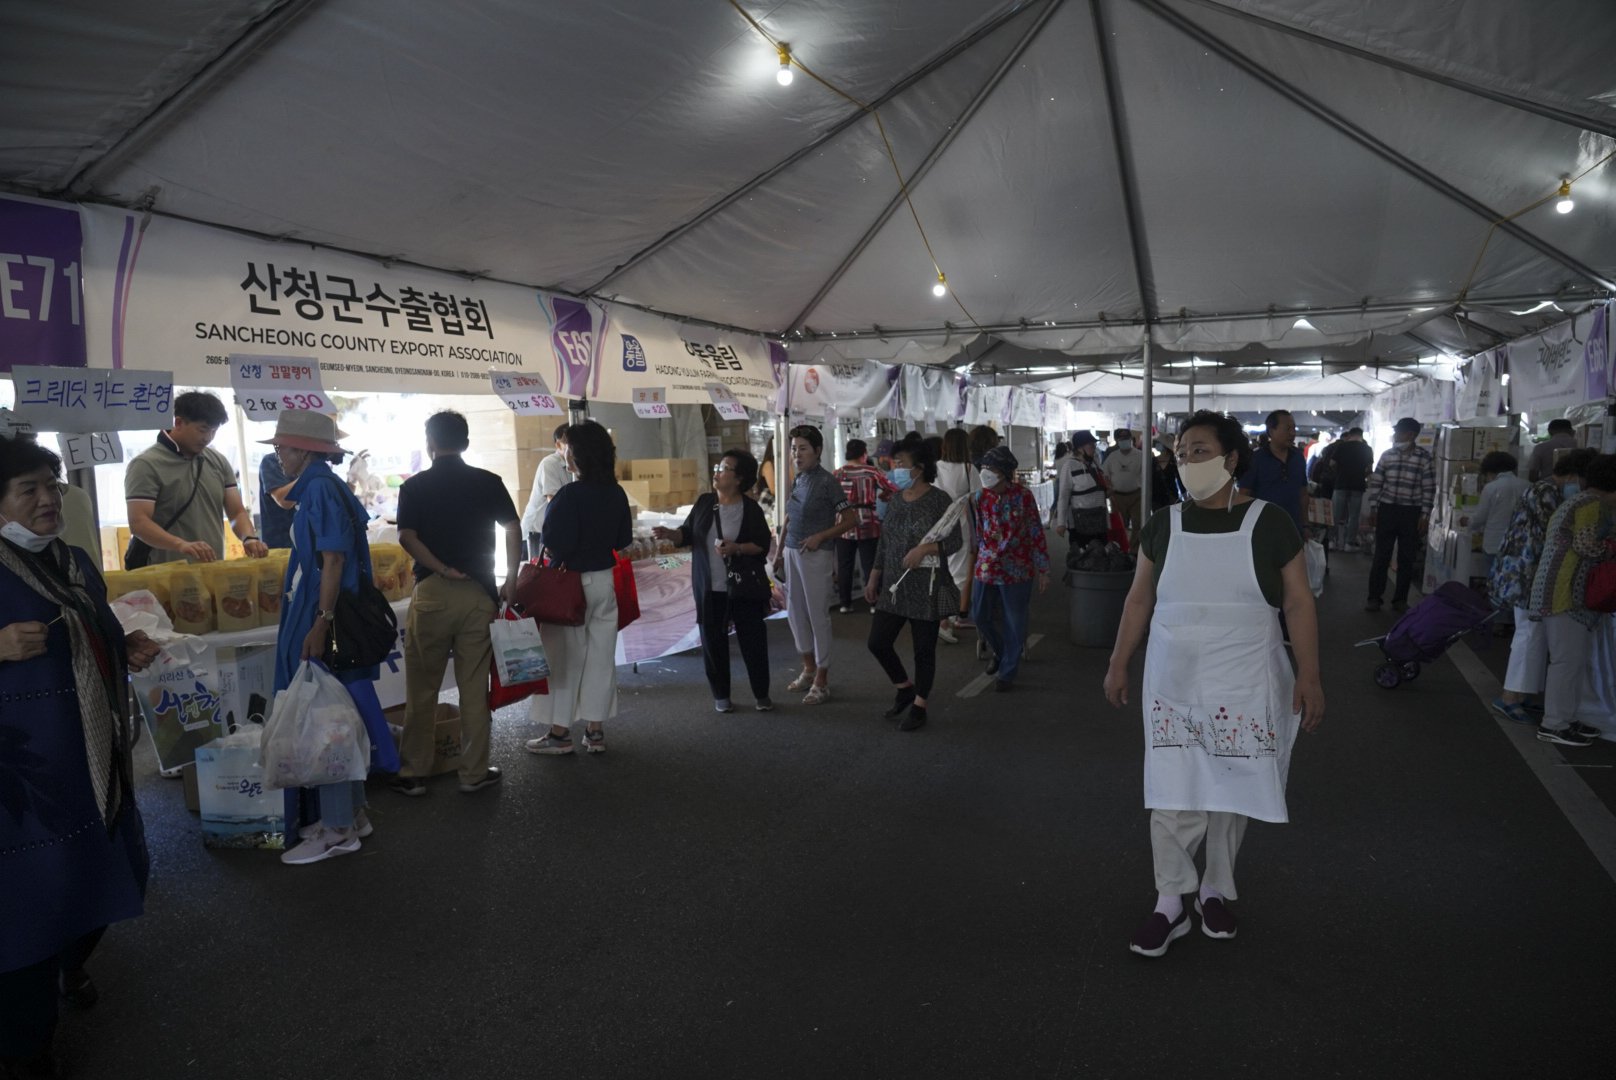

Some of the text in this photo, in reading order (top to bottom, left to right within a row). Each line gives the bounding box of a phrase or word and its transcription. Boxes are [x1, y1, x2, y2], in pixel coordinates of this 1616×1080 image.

[0, 253, 80, 326] E71
[240, 262, 494, 339] 산청군수출협회
[195, 322, 523, 366] SANCHEONG COUNTY EXPORT ASSOCIATION
[206, 356, 230, 365] 2605-B
[240, 365, 262, 379] 산청
[21, 379, 173, 413] 크레딧 카드 환영
[247, 394, 323, 411] 2 for $30
[508, 401, 518, 410] 2
[531, 395, 555, 409] $30
